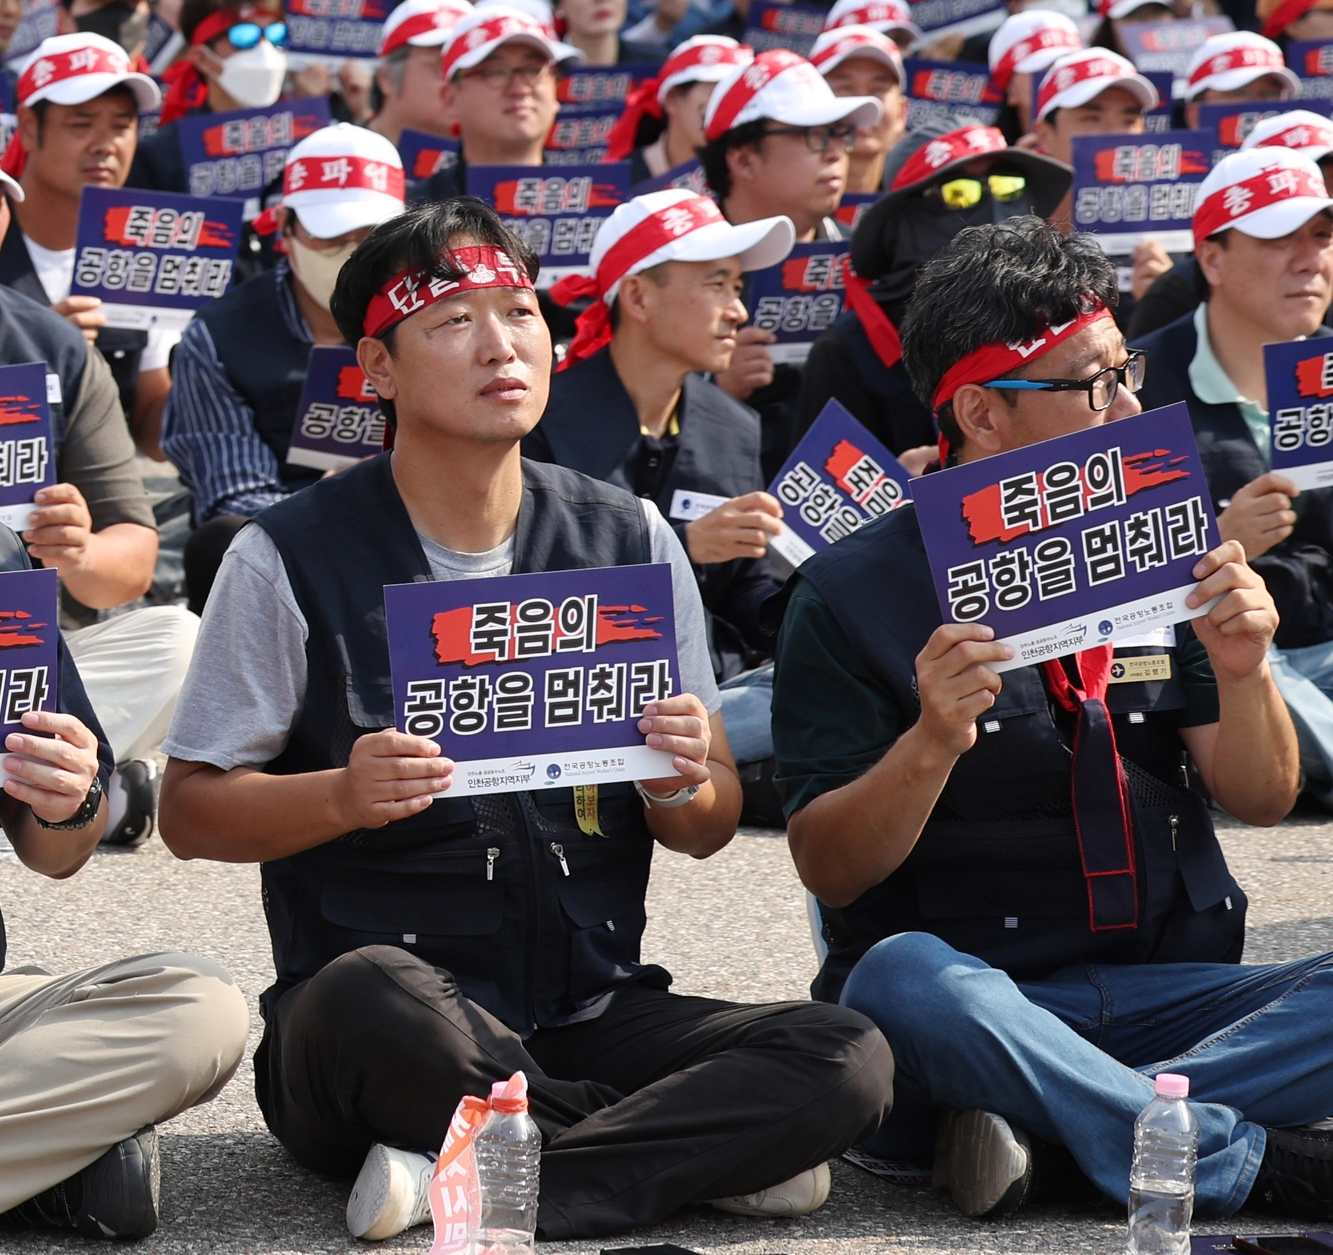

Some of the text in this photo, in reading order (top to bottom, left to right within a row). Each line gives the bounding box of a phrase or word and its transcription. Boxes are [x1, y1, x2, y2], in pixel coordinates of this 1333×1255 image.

[1113, 143, 1182, 182] 죽음의
[514, 176, 593, 215] 죽음의
[1075, 182, 1150, 224] 공항을
[124, 205, 205, 250] 죽음의
[75, 246, 233, 297] 공항을 멈춰라
[999, 446, 1127, 532] 죽음의
[946, 496, 1210, 624] 공항을 멈춰라
[469, 594, 599, 661] 죽음의
[1021, 635, 1085, 660] 인천공항지역지부
[403, 660, 672, 740] 공항을 멈춰라
[467, 774, 531, 789] 인천공항지역지부
